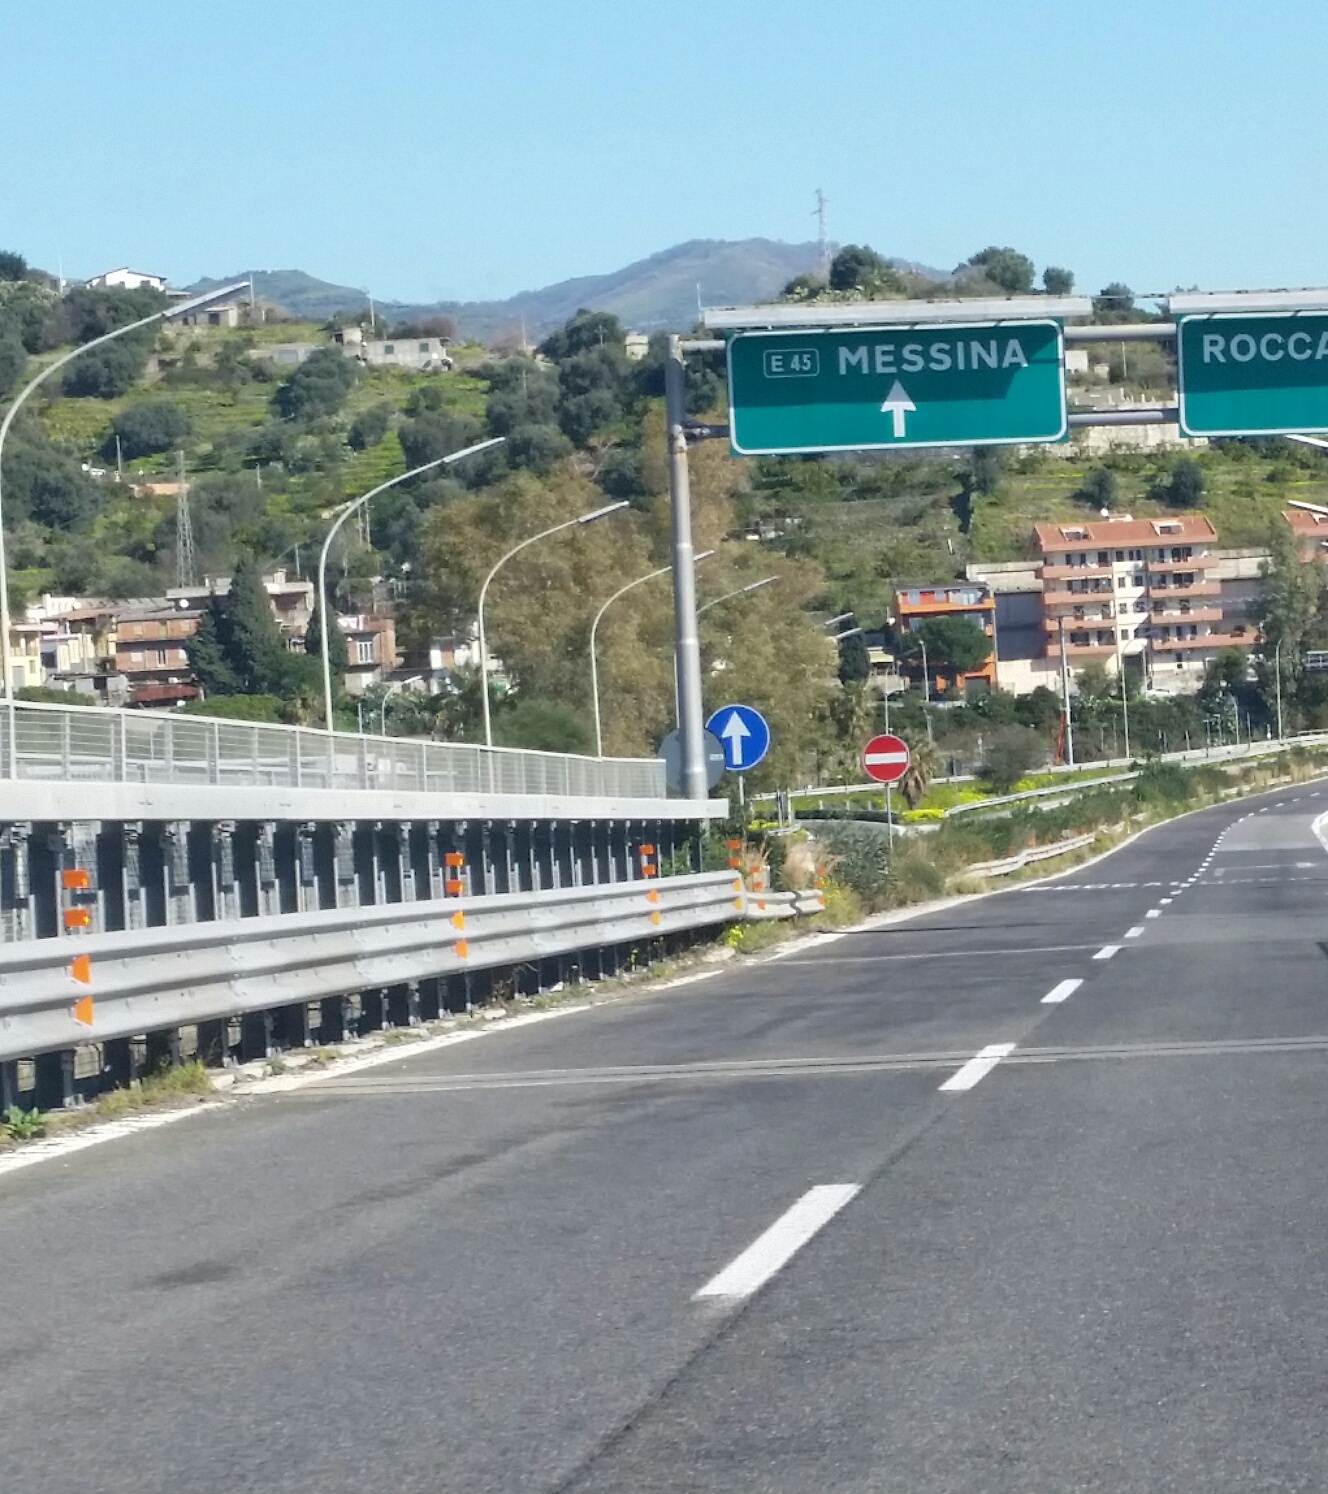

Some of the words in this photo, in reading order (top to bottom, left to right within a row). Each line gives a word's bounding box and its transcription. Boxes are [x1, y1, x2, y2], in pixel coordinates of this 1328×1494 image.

[771, 355, 785, 372] E
[790, 354, 811, 371] 45
[838, 338, 1029, 375] MESSINA
